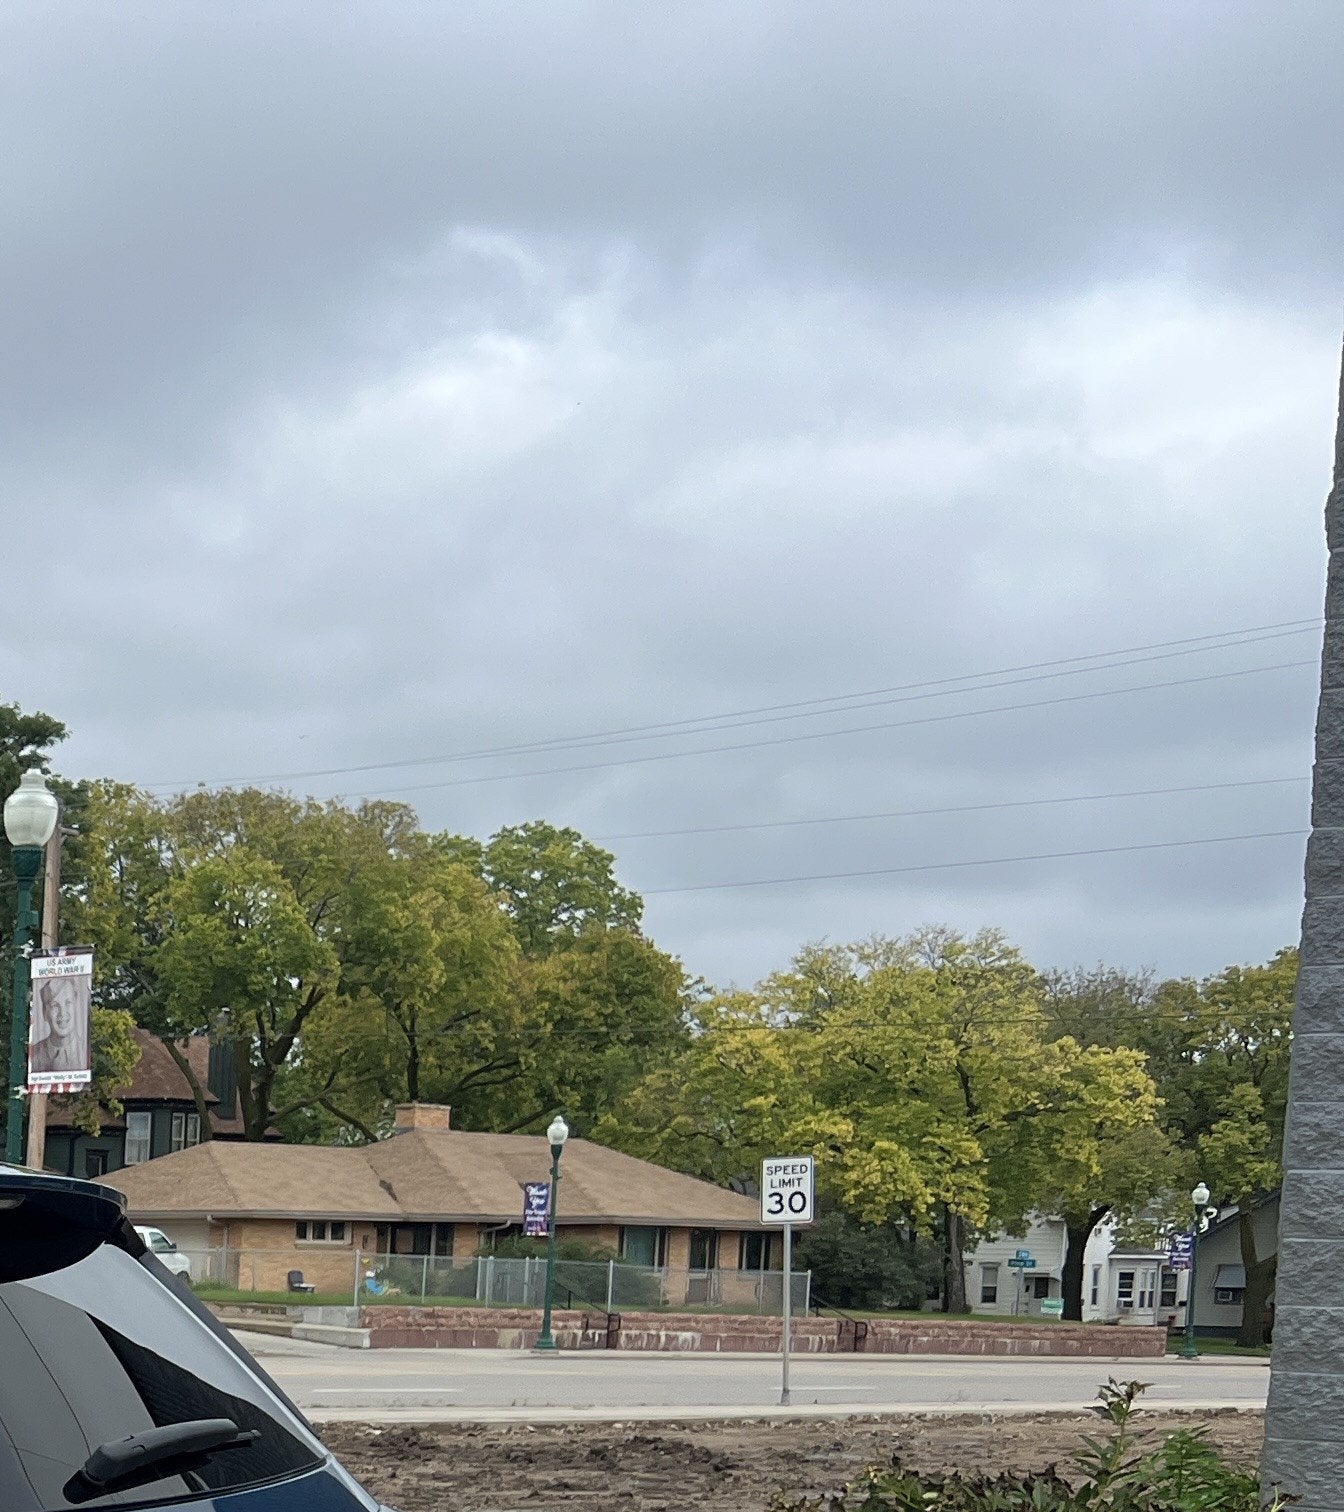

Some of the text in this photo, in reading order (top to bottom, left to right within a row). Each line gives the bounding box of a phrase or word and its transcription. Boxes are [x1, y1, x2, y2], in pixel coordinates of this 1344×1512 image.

[766, 1164, 808, 1176] SPEED
[770, 1177, 803, 1189] LIMIT
[767, 1191, 807, 1215] 30
